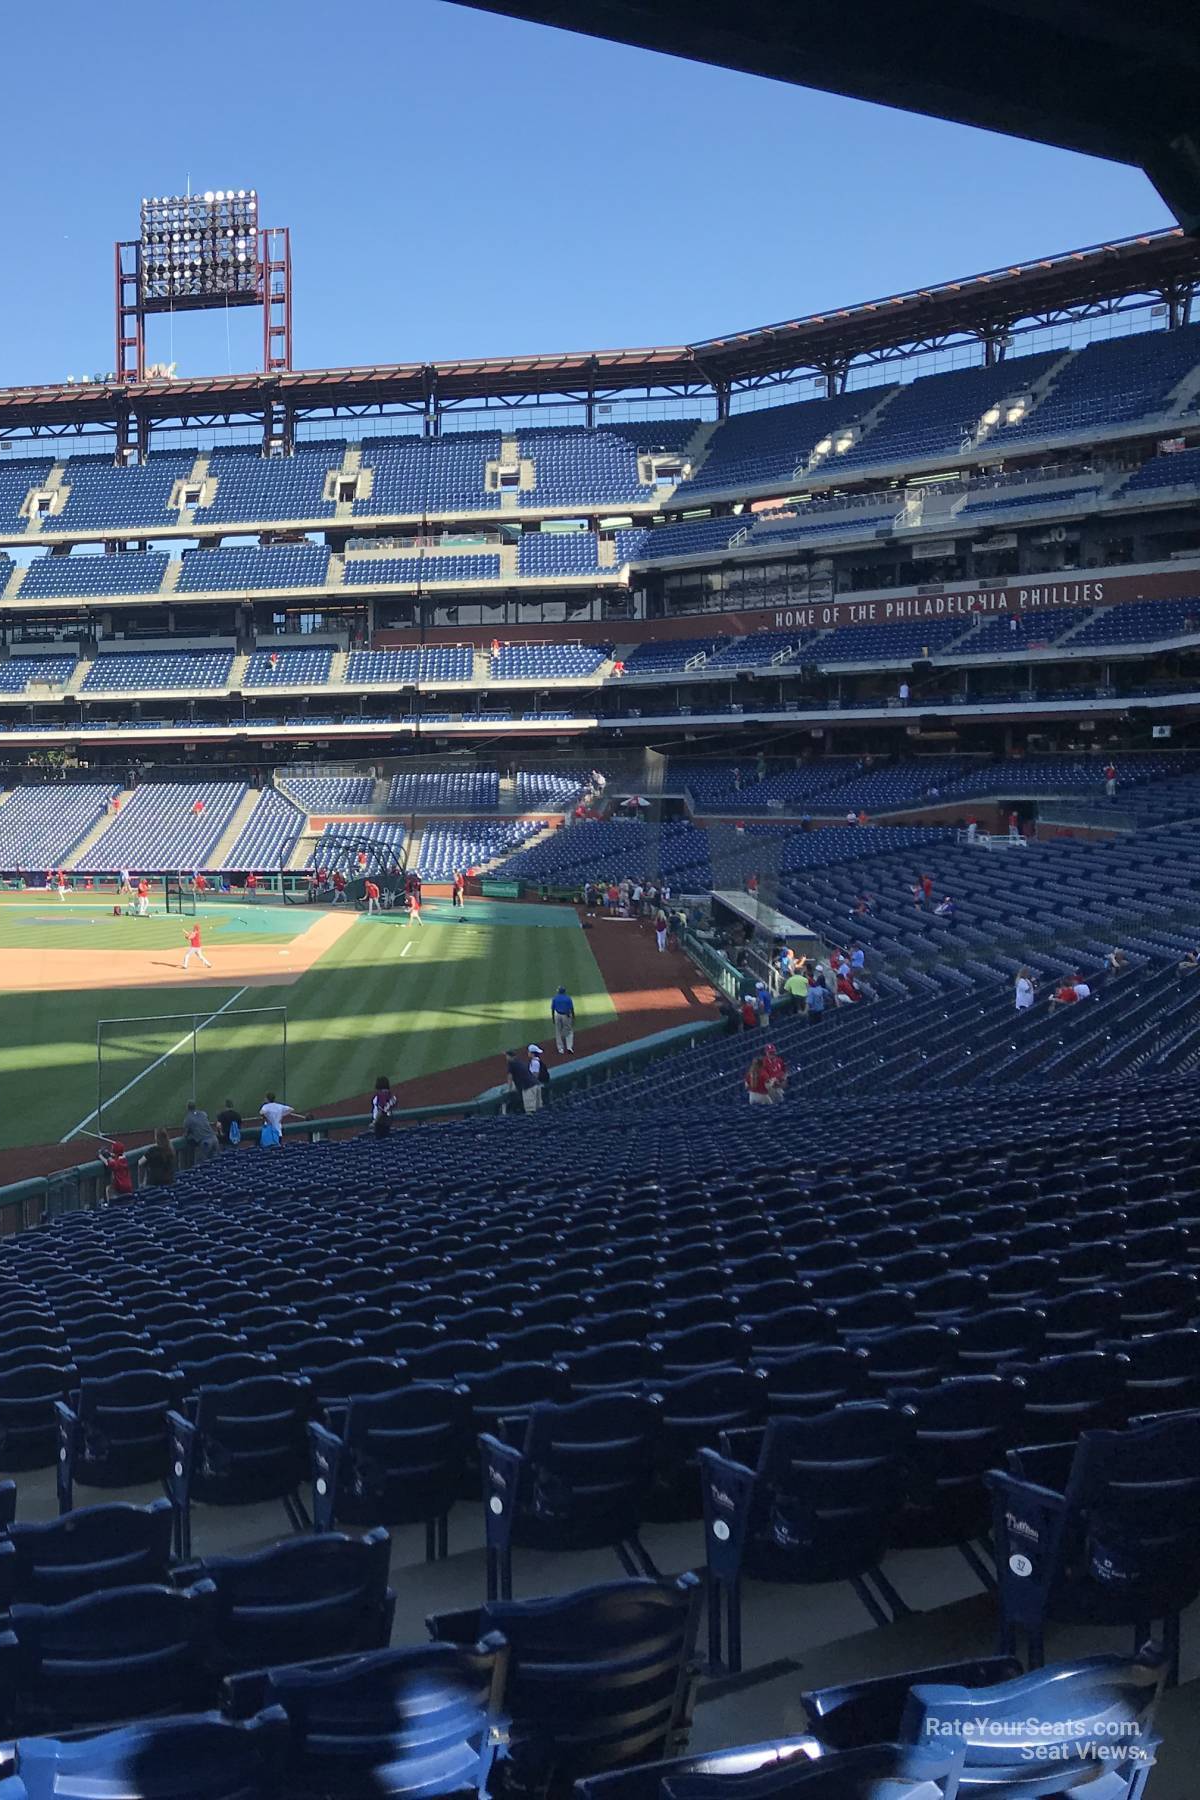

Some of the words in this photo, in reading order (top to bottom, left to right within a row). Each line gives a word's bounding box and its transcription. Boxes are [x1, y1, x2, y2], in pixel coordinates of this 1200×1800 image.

[775, 610, 815, 627] HOME
[822, 607, 840, 623] OF
[849, 604, 876, 621] THE
[886, 591, 1008, 617] PHILADELPHIA
[1020, 583, 1104, 608] PHILLIES
